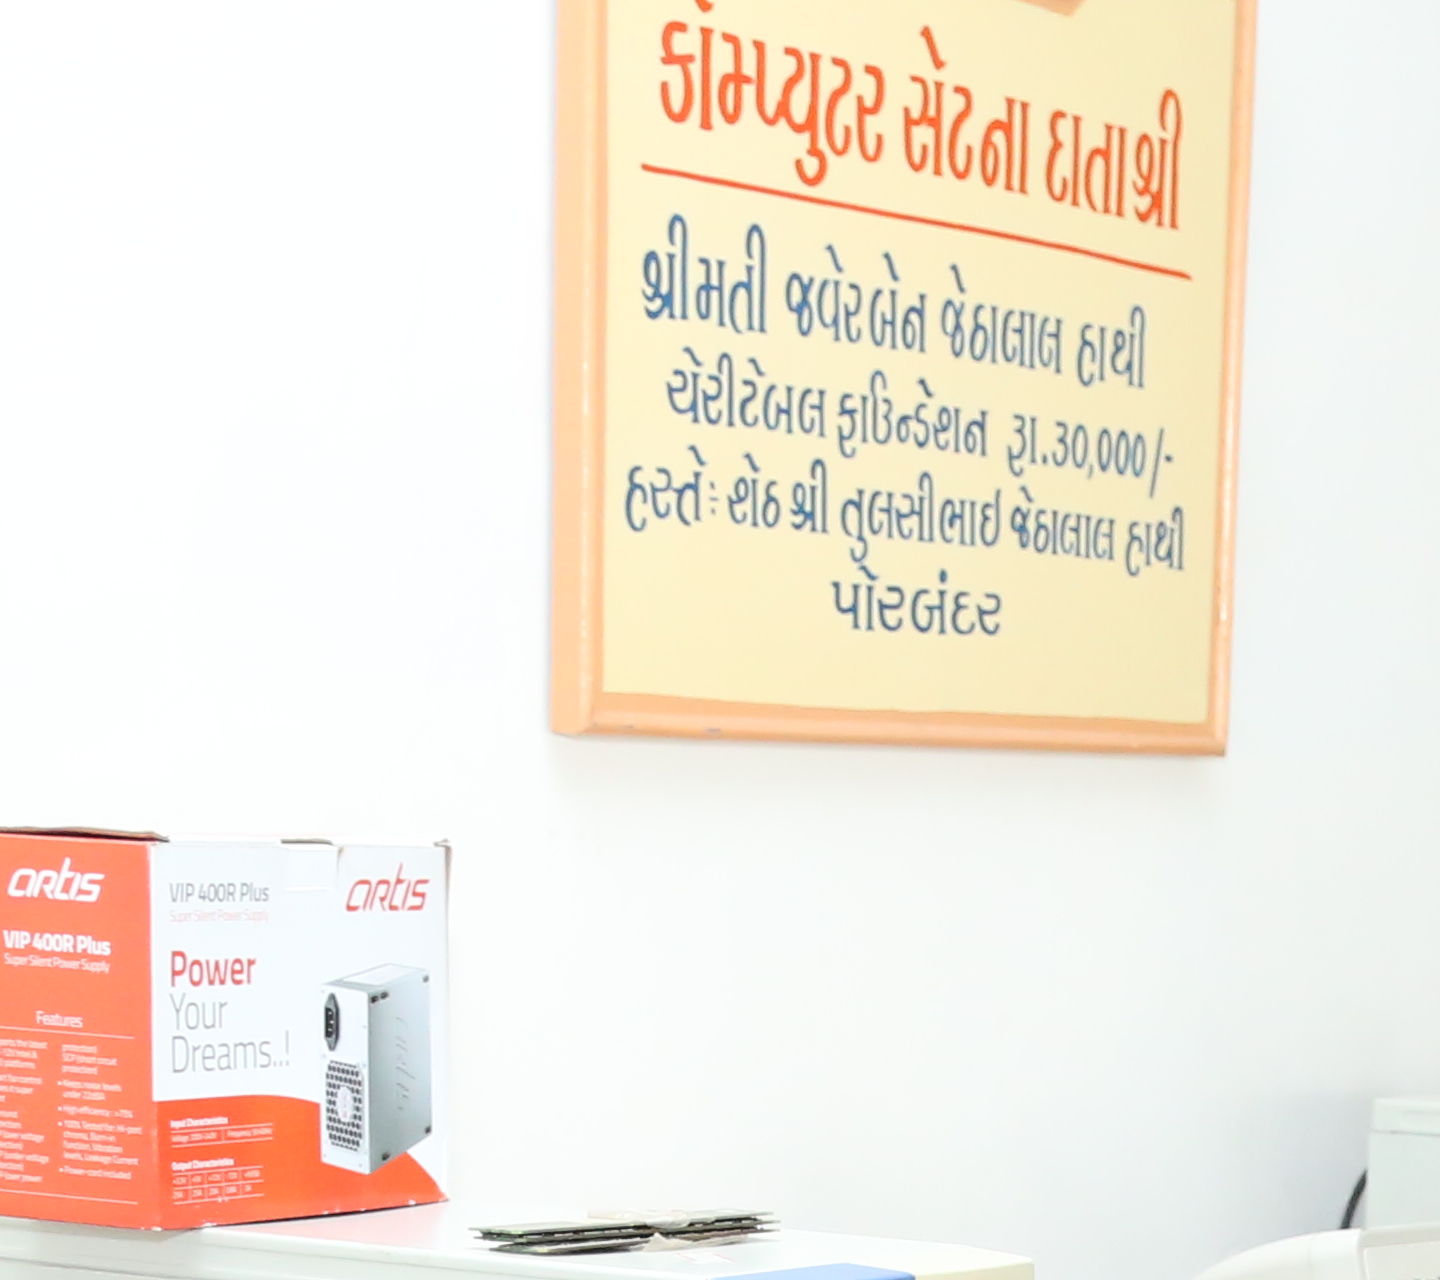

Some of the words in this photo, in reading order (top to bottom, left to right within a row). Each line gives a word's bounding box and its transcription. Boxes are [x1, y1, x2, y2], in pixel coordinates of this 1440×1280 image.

[642, 213, 767, 334] શ્રીમતી
[1077, 305, 1146, 388] હાથી
[790, 458, 829, 533] શ્રી
[1125, 506, 1184, 577] હાથી
[832, 564, 1003, 637] પોરબંદર
[169, 882, 195, 903] VIP
[198, 882, 236, 903] 400R
[239, 881, 270, 903] Plus
[2, 929, 30, 949] VIP
[33, 932, 74, 953] 400R
[77, 935, 112, 956] Plus
[4, 952, 28, 968] Super
[28, 954, 53, 968] Silent
[53, 956, 80, 970] Power
[169, 949, 256, 987] Power
[35, 1010, 83, 1029] Features
[169, 993, 227, 1032] Your
